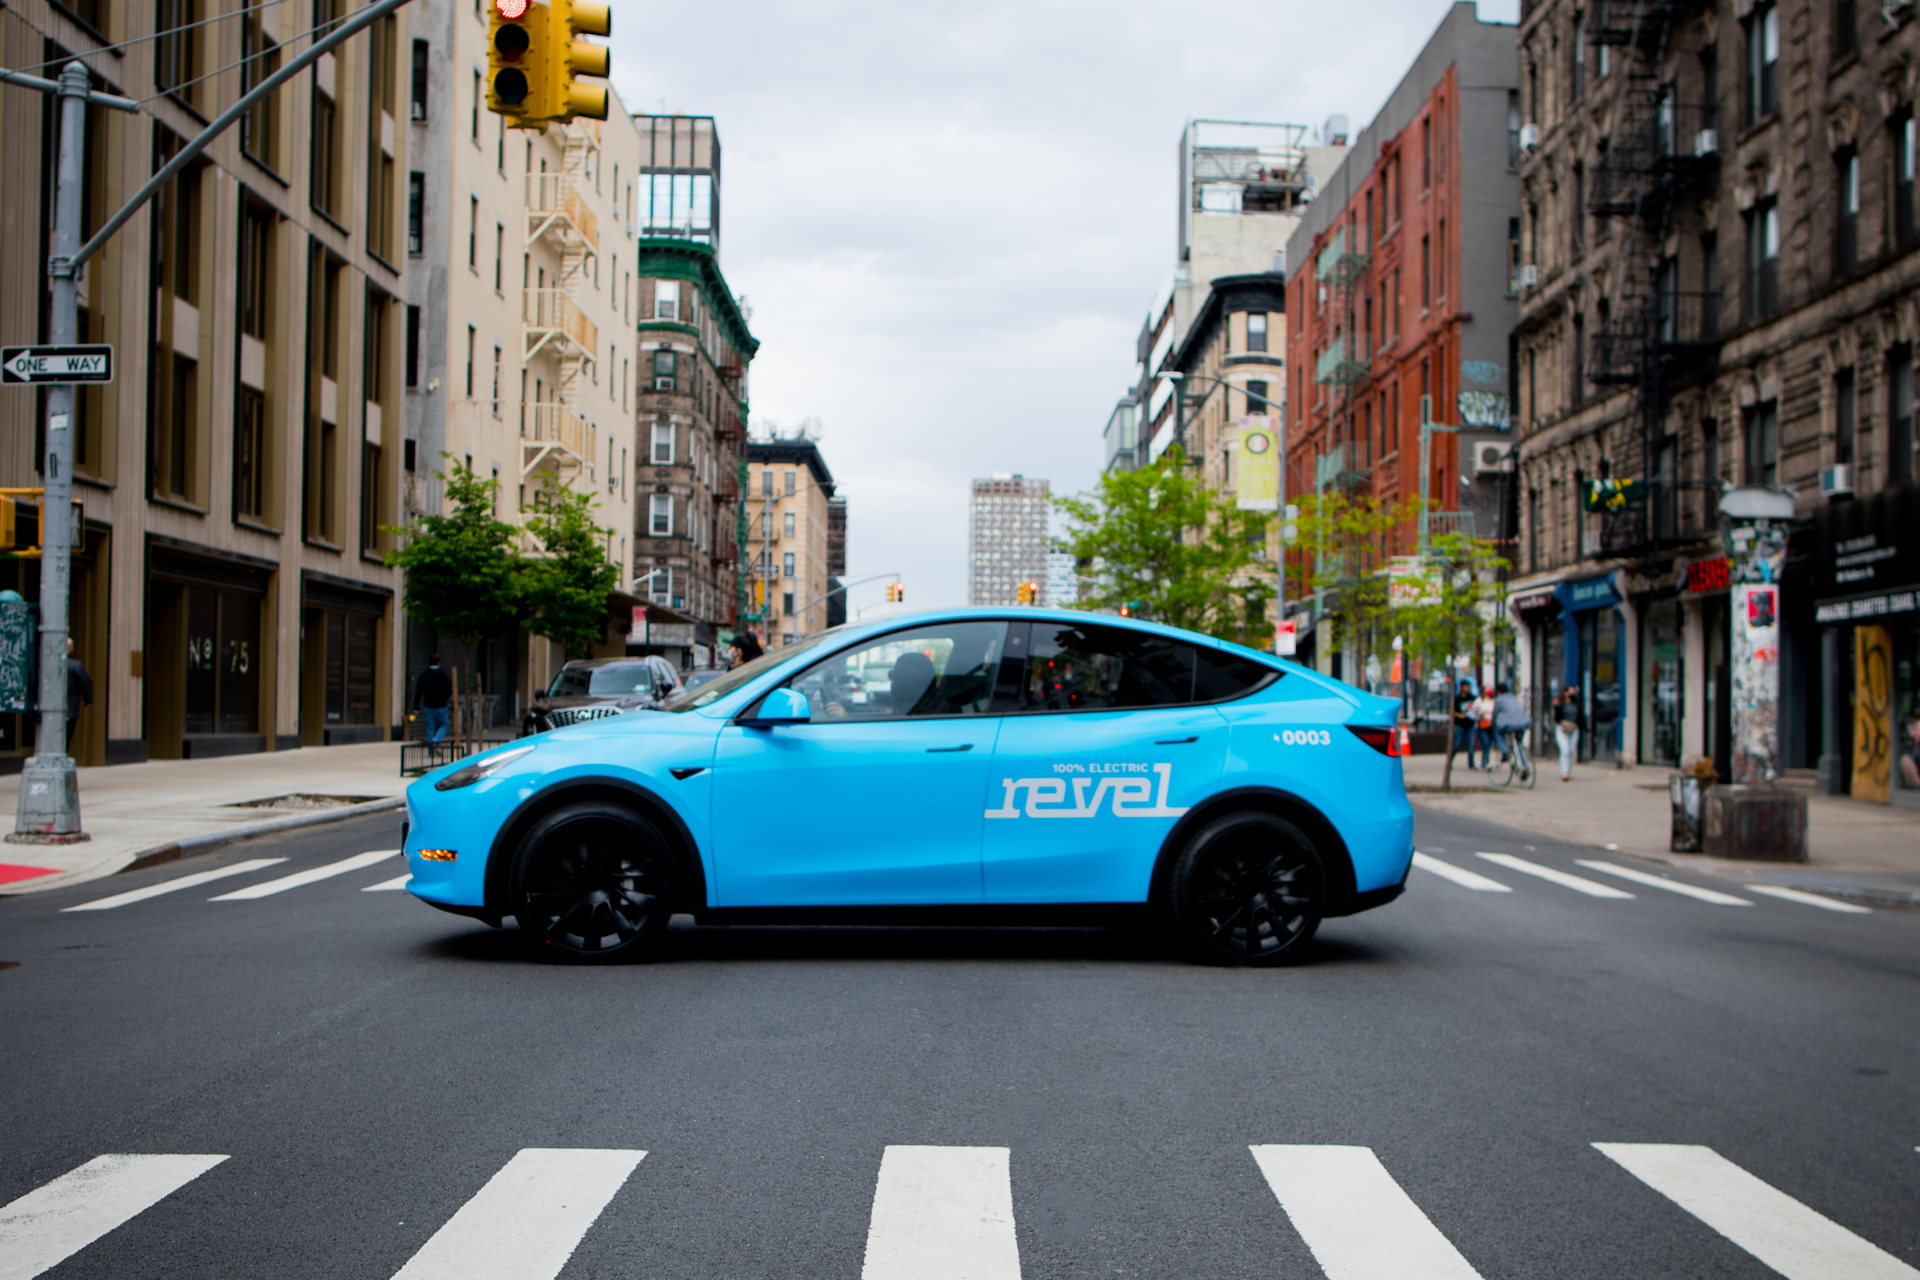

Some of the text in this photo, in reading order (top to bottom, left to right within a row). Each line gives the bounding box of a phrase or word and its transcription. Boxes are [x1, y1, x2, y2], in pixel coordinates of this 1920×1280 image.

[16, 356, 101, 372] ONE WAY
[230, 640, 249, 673] 75
[1282, 729, 1331, 746] 0003
[1053, 763, 1149, 773] 100% ELECTRIC
[984, 762, 1191, 819] revel
